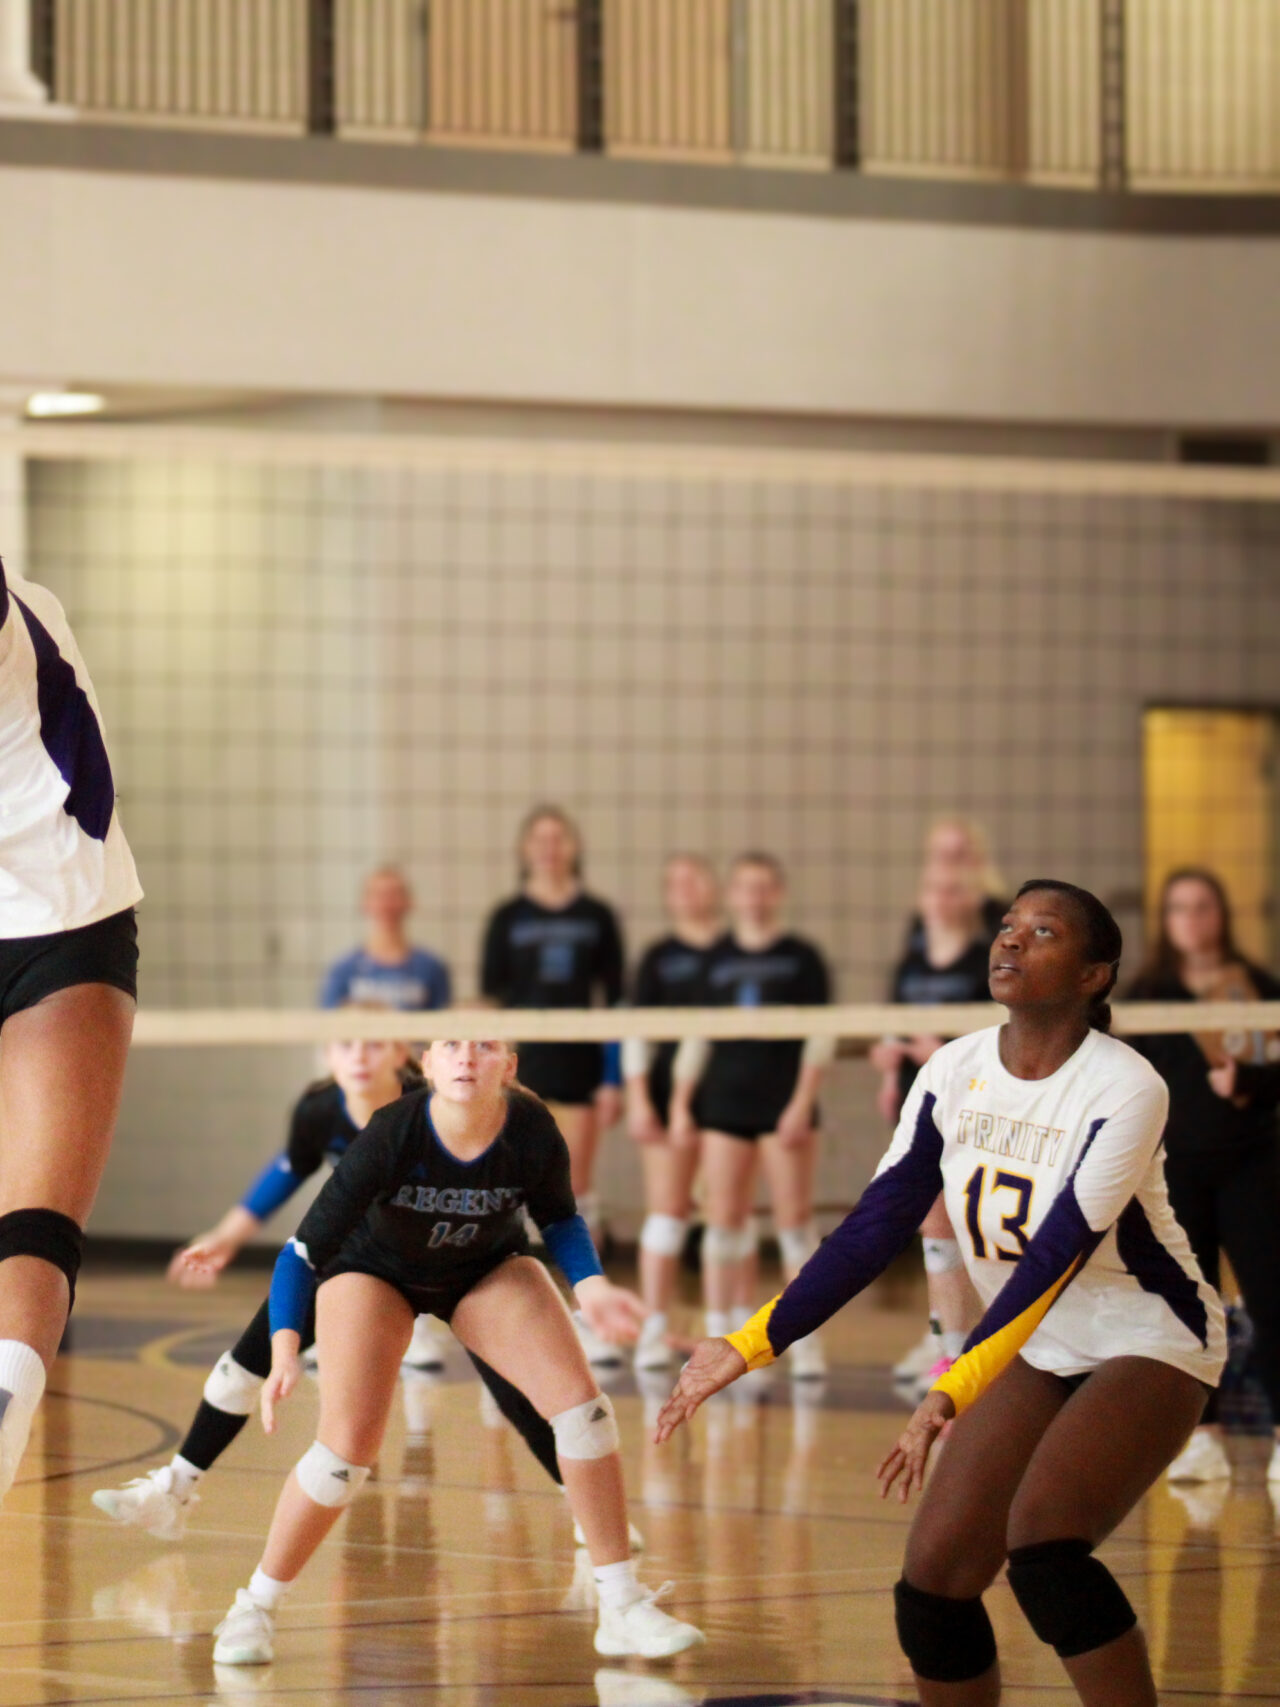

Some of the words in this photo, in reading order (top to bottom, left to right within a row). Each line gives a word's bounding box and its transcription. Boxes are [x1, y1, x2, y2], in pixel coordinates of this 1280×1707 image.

[957, 1109, 1066, 1168] TRINITY
[427, 1221, 479, 1248] 14
[963, 1163, 1036, 1262] 13
